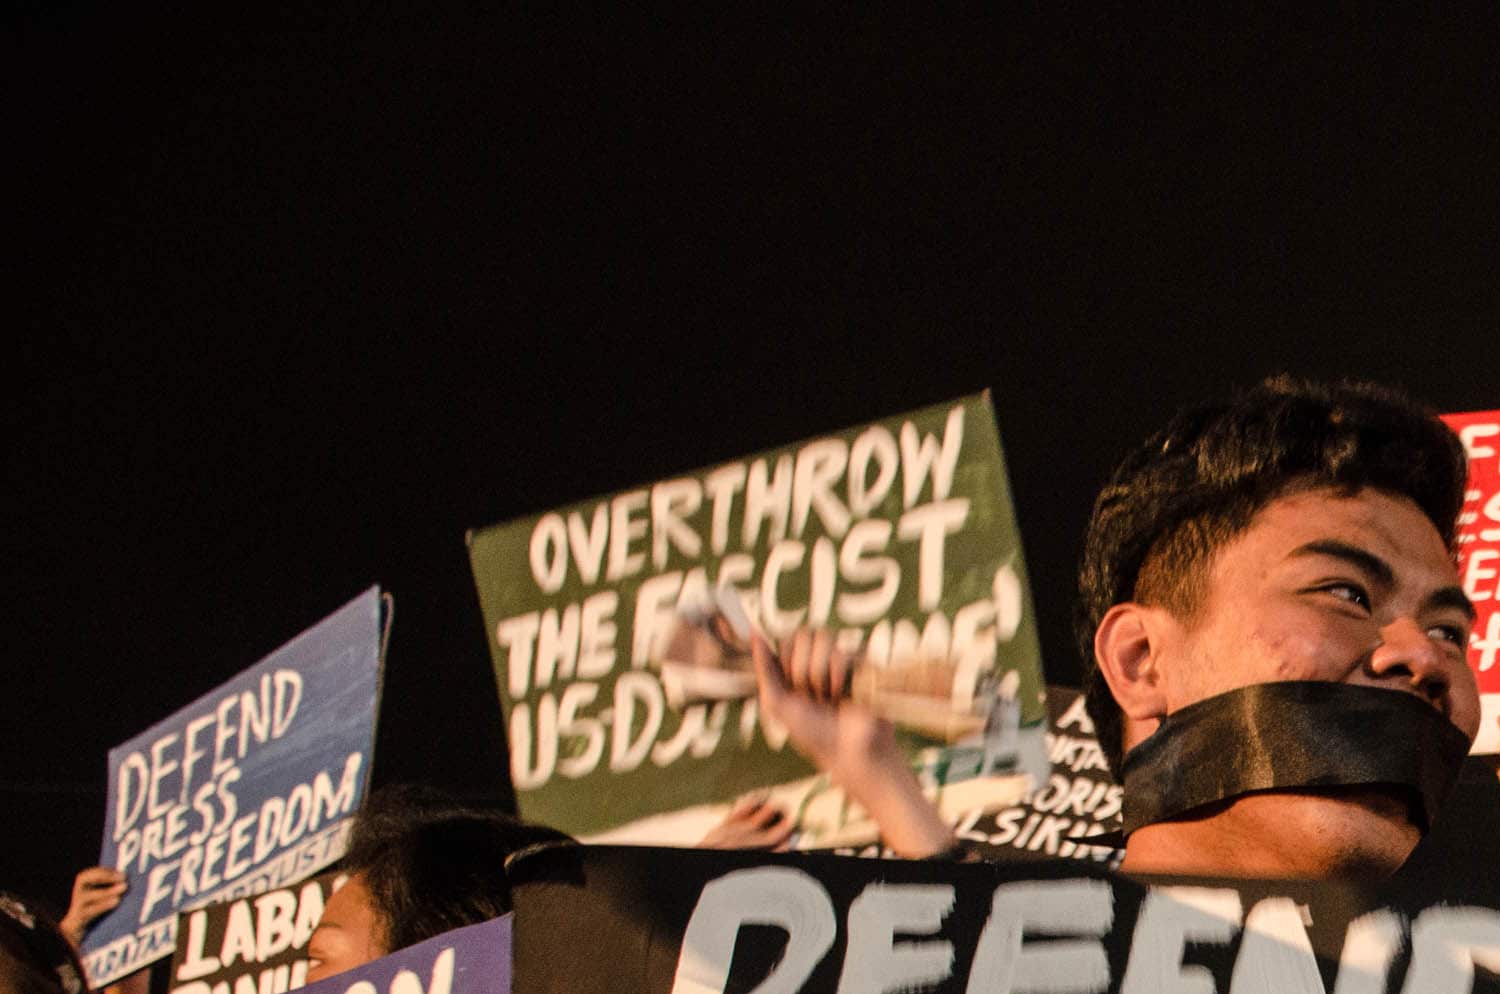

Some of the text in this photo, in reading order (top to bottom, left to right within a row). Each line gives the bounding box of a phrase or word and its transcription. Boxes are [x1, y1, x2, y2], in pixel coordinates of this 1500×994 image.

[529, 405, 965, 594] OVERTHROW
[498, 591, 617, 698] THE
[115, 668, 303, 841] DEFEND
[116, 766, 242, 874] PRESS
[139, 751, 363, 924] FREEDOM
[177, 875, 350, 982] LABA
